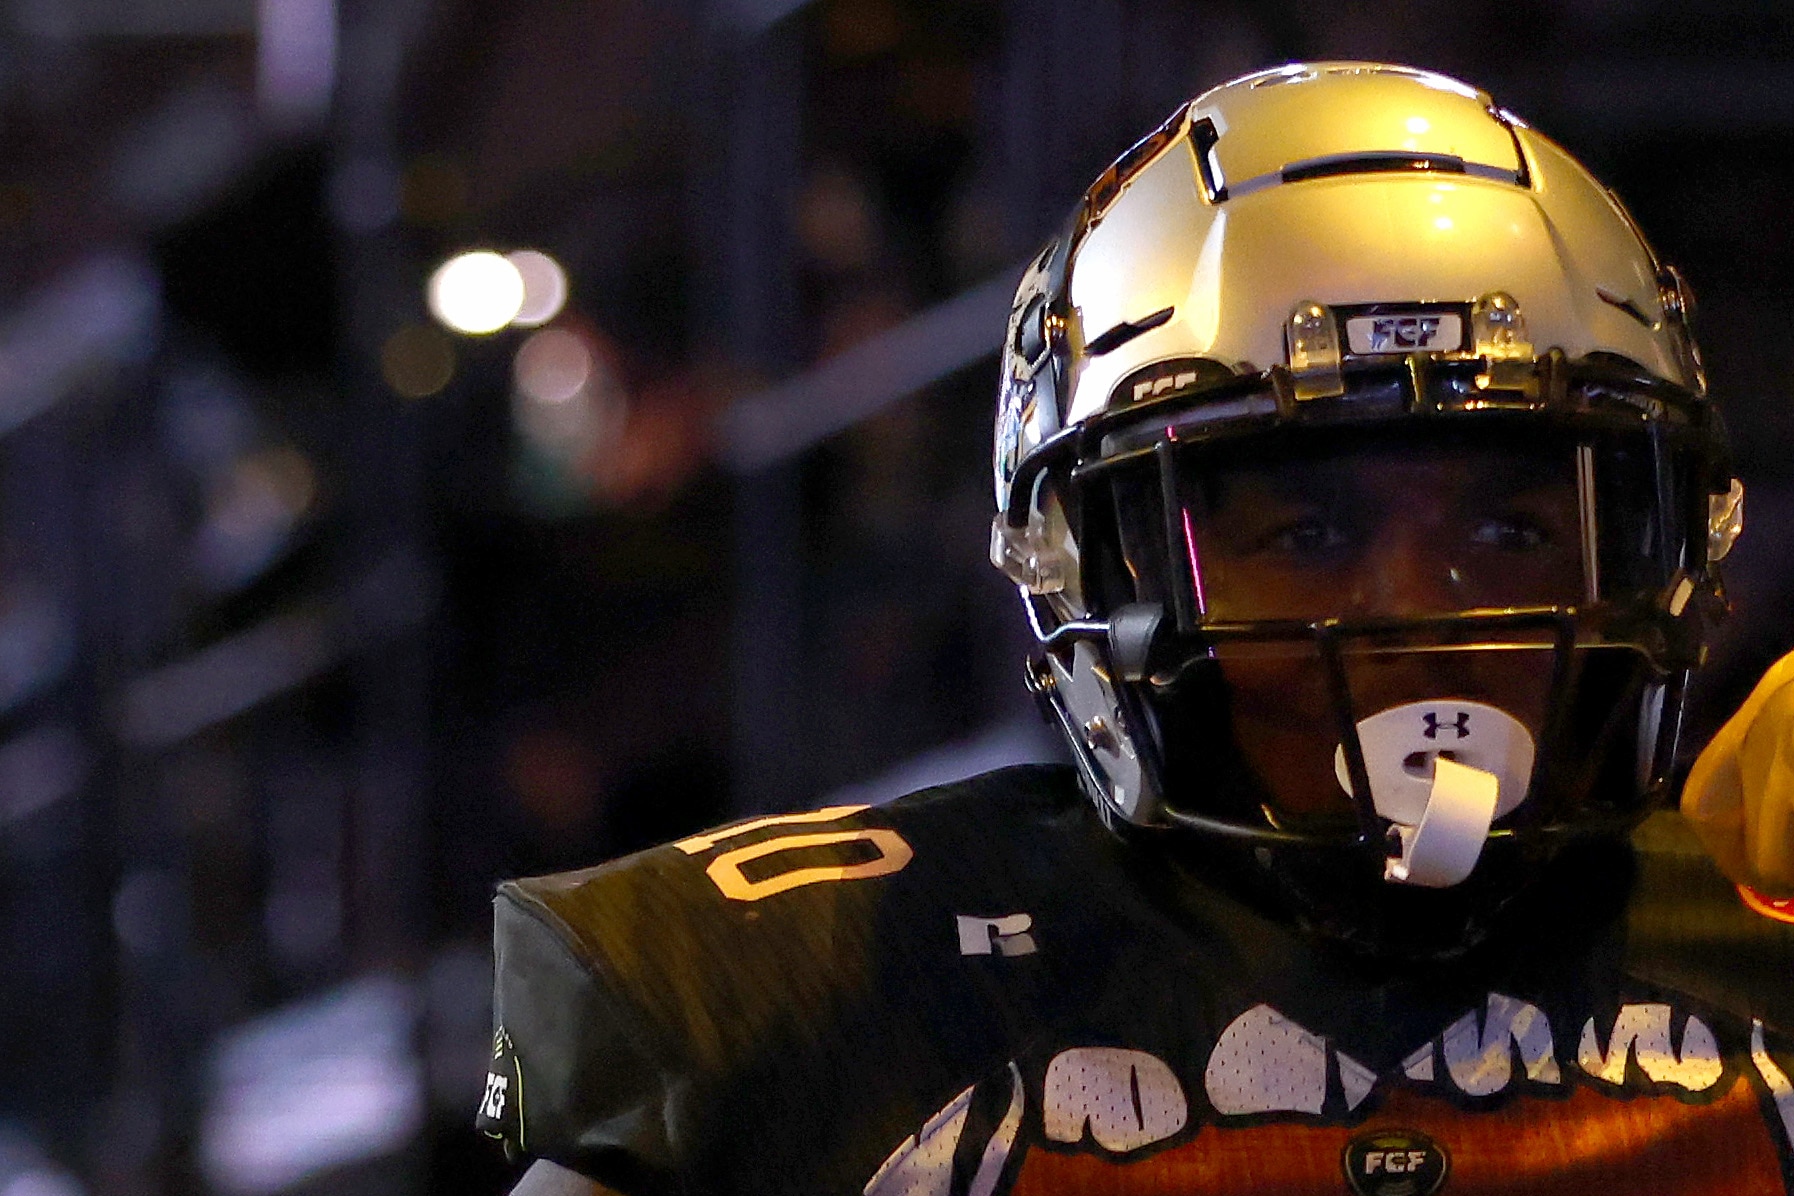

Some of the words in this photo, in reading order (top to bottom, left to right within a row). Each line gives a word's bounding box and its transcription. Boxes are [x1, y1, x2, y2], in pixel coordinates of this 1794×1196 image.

[1372, 318, 1440, 349] FCF
[673, 804, 914, 901] 10
[1366, 1151, 1427, 1174] FCF
